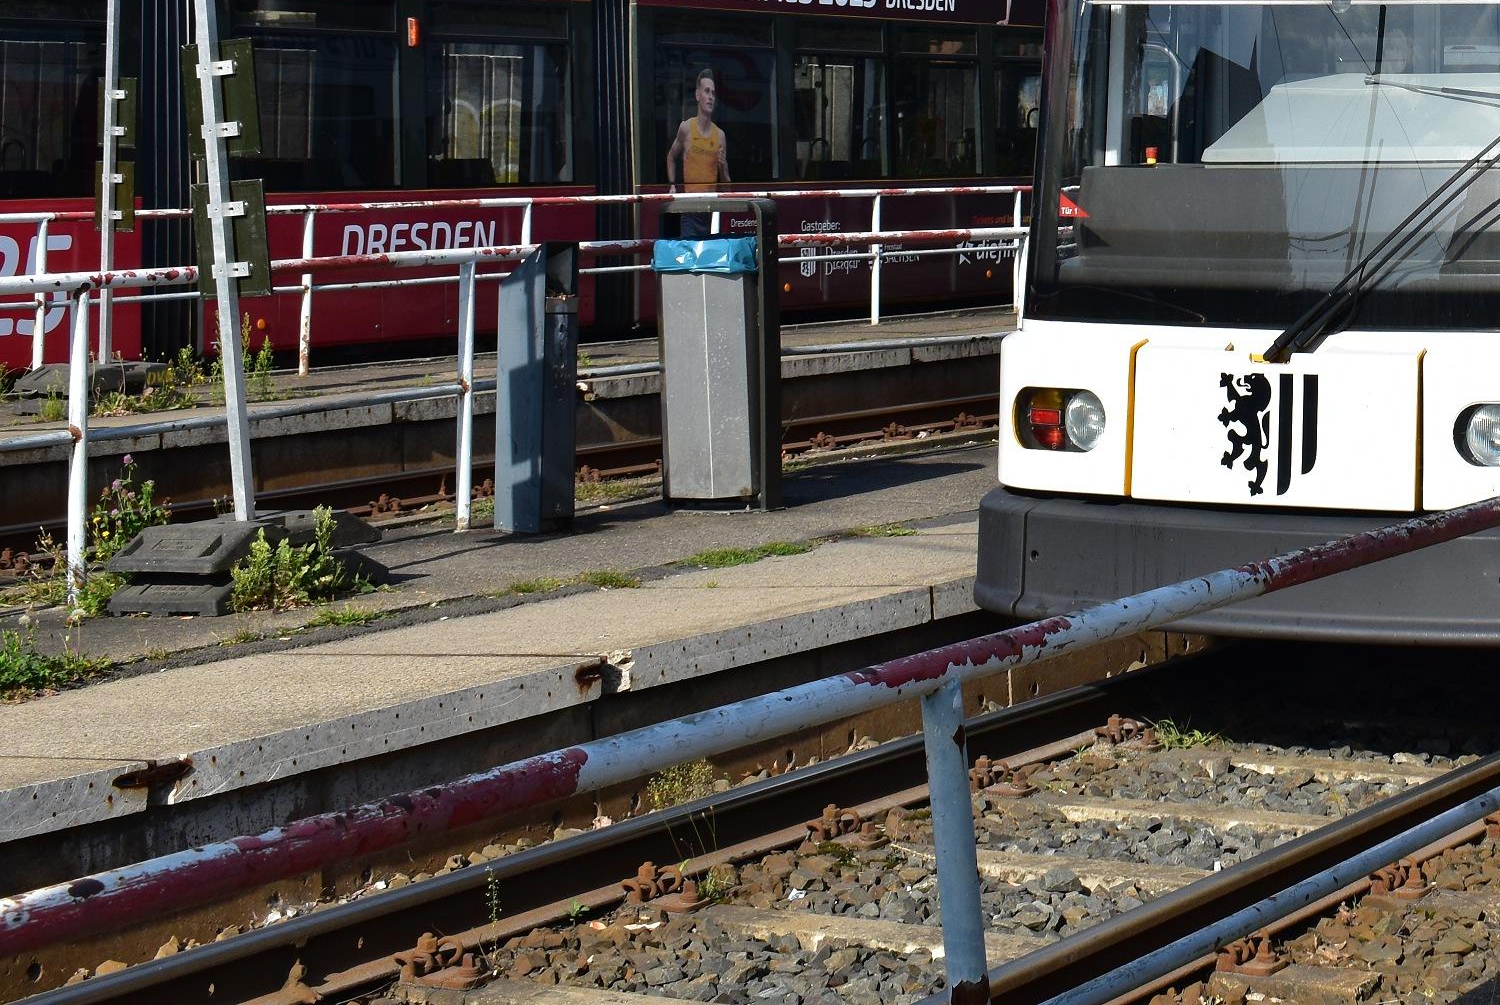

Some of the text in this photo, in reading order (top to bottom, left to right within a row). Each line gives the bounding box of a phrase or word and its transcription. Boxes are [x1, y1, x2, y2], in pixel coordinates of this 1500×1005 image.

[1060, 207, 1073, 215] Tür
[801, 220, 841, 233] Gastgeber:
[341, 220, 496, 257] DRESDEN
